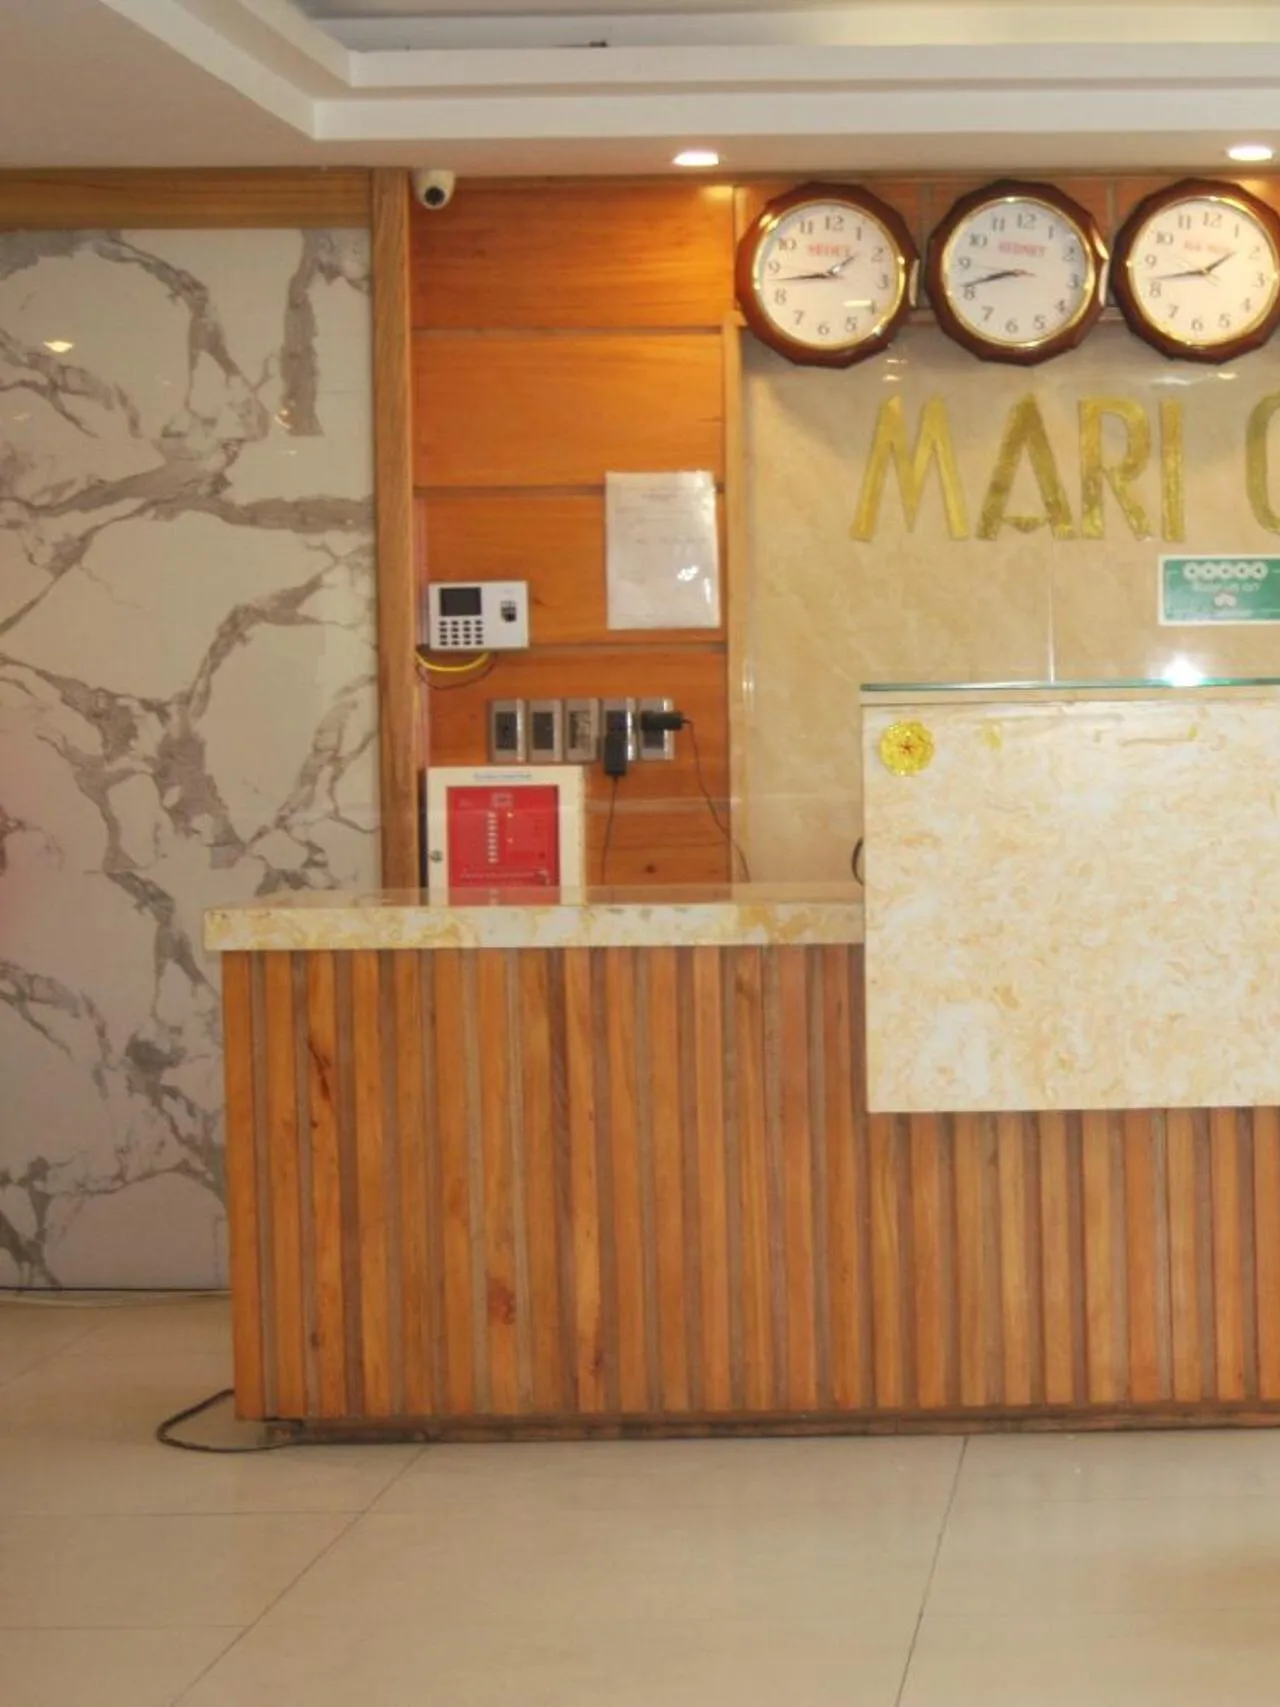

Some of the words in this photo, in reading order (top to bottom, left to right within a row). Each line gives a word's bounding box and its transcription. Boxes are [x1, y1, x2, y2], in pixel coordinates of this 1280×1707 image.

[801, 221, 813, 234] 11
[825, 215, 844, 231] 12
[992, 216, 1005, 232] 11
[1017, 213, 1036, 229] 12
[1178, 214, 1191, 230] 11
[1203, 212, 1222, 228] 12
[778, 237, 797, 250] 10
[969, 233, 988, 247] 10
[1156, 231, 1174, 245] 10
[872, 248, 883, 262] 2
[1145, 255, 1157, 268] 9
[769, 260, 781, 273] 9
[958, 257, 971, 270] 9
[877, 274, 889, 290] 3
[1067, 274, 1079, 289] 3
[1252, 272, 1265, 288] 3
[774, 288, 787, 304] 8
[1149, 282, 1161, 298] 8
[982, 306, 994, 321] 7
[1054, 300, 1065, 313] 4
[1168, 304, 1179, 319] 7
[793, 310, 804, 325] 7
[845, 317, 857, 332] 5
[1033, 315, 1045, 330] 5
[1191, 317, 1203, 331] 6
[1218, 313, 1230, 328] 5
[818, 321, 830, 336] 6
[1006, 318, 1018, 333] 6
[851, 391, 1185, 542] MARI
